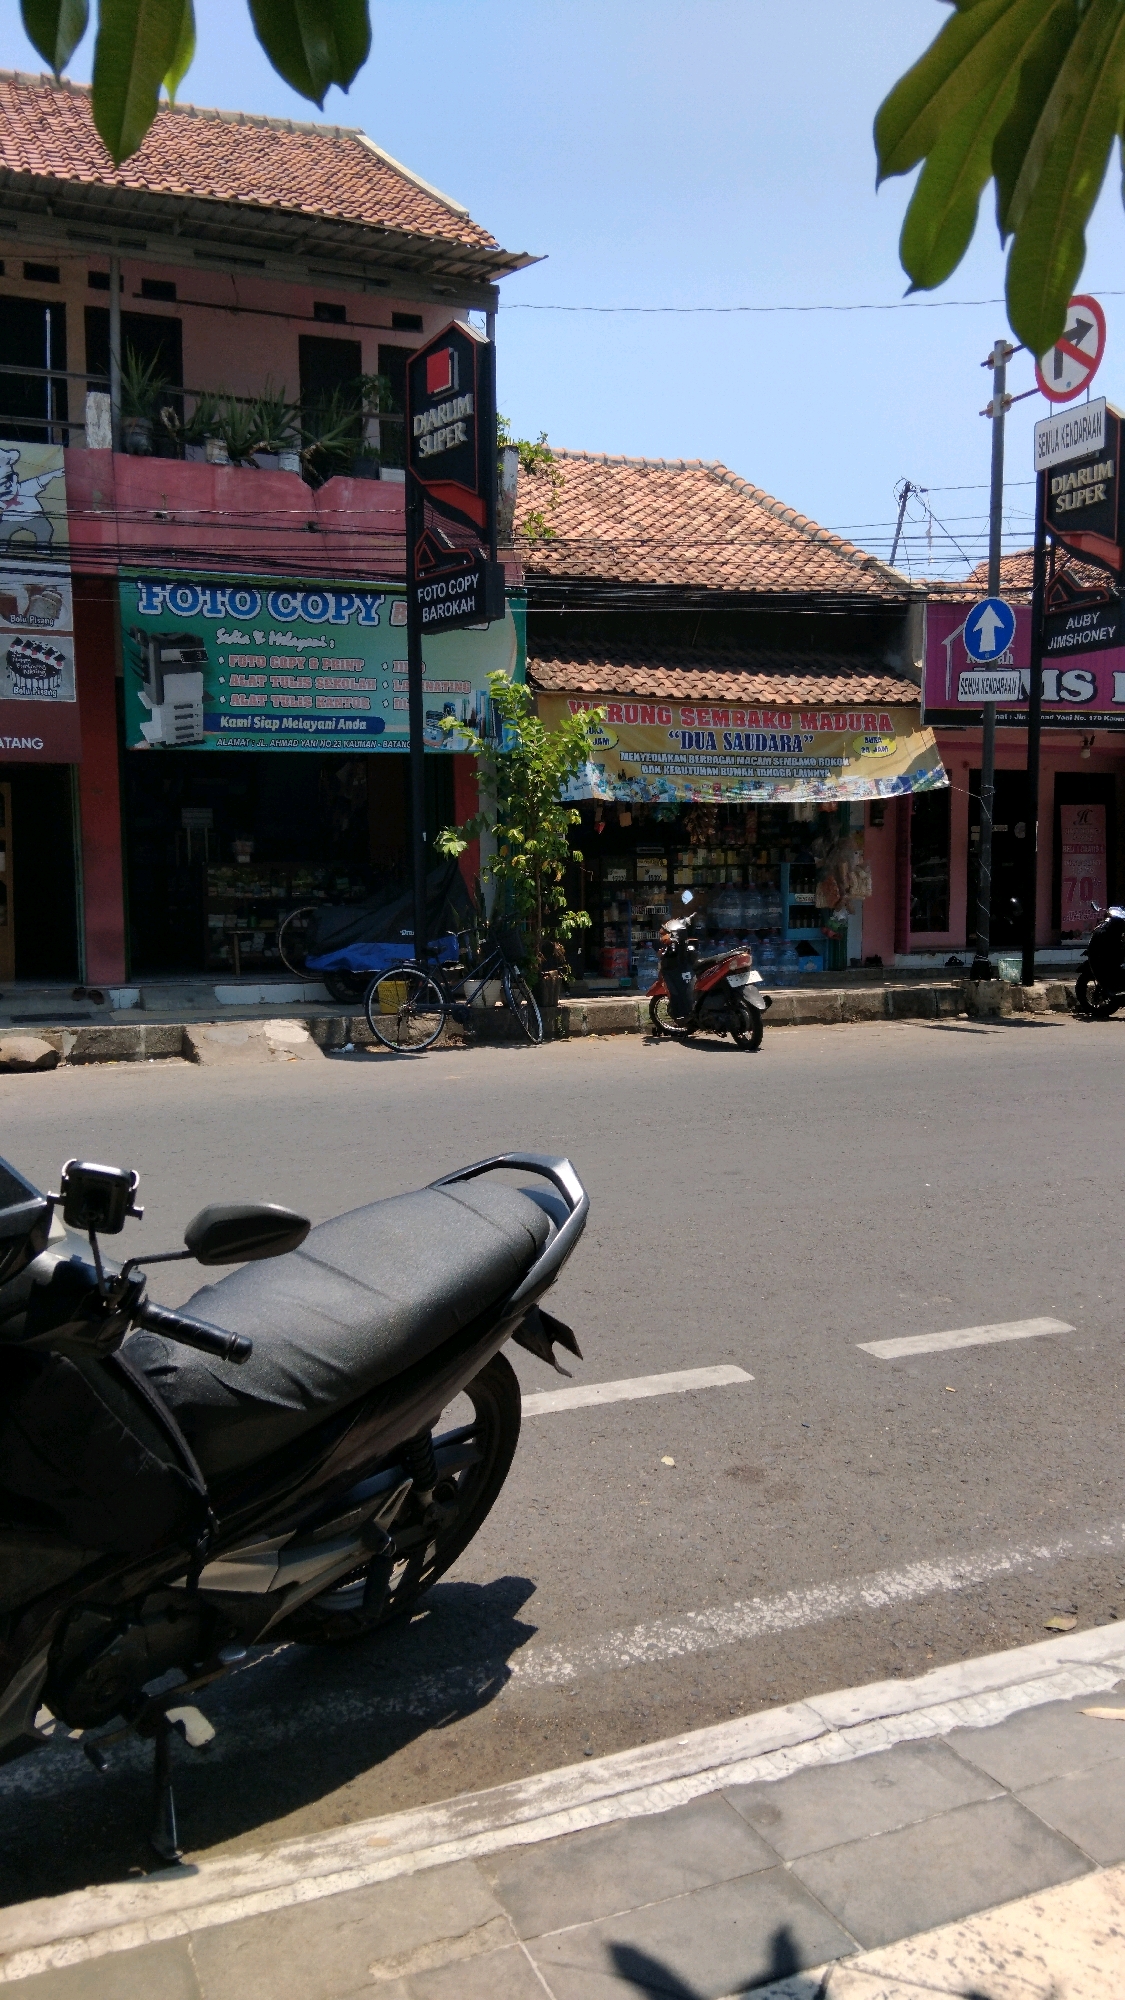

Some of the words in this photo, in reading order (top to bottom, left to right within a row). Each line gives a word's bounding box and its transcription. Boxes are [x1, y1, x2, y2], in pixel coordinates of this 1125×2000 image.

[413, 393, 474, 436] DJARUM
[1061, 411, 1102, 449] KENDARAAN
[418, 421, 468, 458] SUPER
[1051, 460, 1115, 495] DJARUM
[1055, 483, 1107, 513] SUPER
[417, 582, 447, 603] FOTO
[448, 573, 480, 595] COPY
[137, 582, 262, 620] FOTO
[266, 589, 386, 626] COPY
[422, 596, 475, 622] BAROKAH
[10, 614, 27, 624] Bolu
[29, 616, 55, 627] Pisang
[1065, 611, 1101, 630] AUBY
[1047, 625, 1116, 650] JIMSHONEY
[228, 655, 267, 668] FOTO
[270, 656, 307, 670] COPY
[321, 657, 365, 672] PRINT
[229, 674, 267, 688] ALAT
[270, 675, 313, 690] TULIS
[314, 676, 377, 692] SEKOLAH
[32, 687, 57, 698] Pisang
[229, 694, 268, 708] ALAT
[270, 694, 313, 709] TULIS
[315, 696, 371, 710] KANTOR
[220, 716, 252, 729] Kami
[253, 717, 280, 731] Siap
[282, 717, 336, 732] Melayani
[337, 719, 368, 730] Anda
[680, 707, 793, 730] SEMBAKO
[799, 713, 895, 732] MADURA
[216, 738, 250, 748] ALAMAT
[256, 739, 268, 748] JL.
[270, 739, 299, 749] AHMAD
[300, 740, 319, 749] YANI
[319, 740, 342, 749] NO.23
[343, 740, 376, 749] KAUMAN
[592, 737, 610, 746] JAM
[864, 736, 882, 744] BUKA
[872, 745, 889, 753] JAM
[620, 752, 687, 763] MENYEDIAKAN
[688, 753, 735, 765] BERBAGAI
[736, 755, 772, 766] MACAM
[773, 757, 817, 767] SEMBAKO
[818, 757, 850, 767] ROKOK
[642, 765, 662, 775] DAN
[663, 766, 720, 777] KEBUTUHAN
[721, 767, 754, 777] RUMAH
[755, 768, 792, 778] TANGGA
[793, 769, 832, 778] LAINNYA
